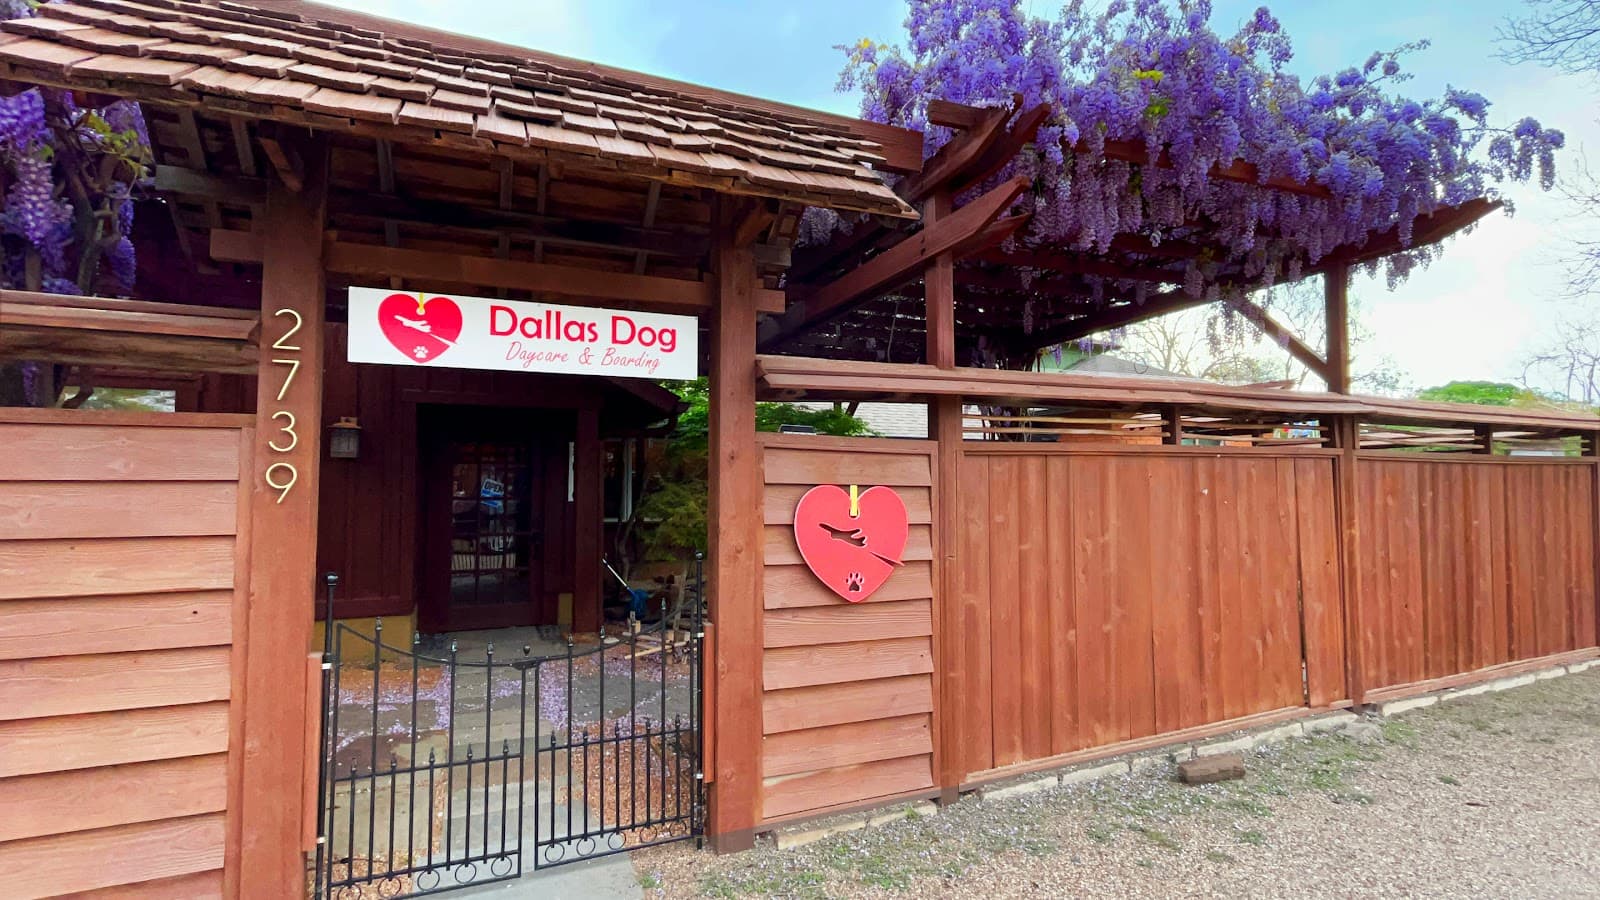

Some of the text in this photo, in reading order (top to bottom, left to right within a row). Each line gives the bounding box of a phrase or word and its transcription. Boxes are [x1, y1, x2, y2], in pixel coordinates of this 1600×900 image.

[489, 303, 678, 354] Dallas Dog
[505, 341, 660, 374] Daycare & Boarding
[265, 308, 302, 504] 2739
